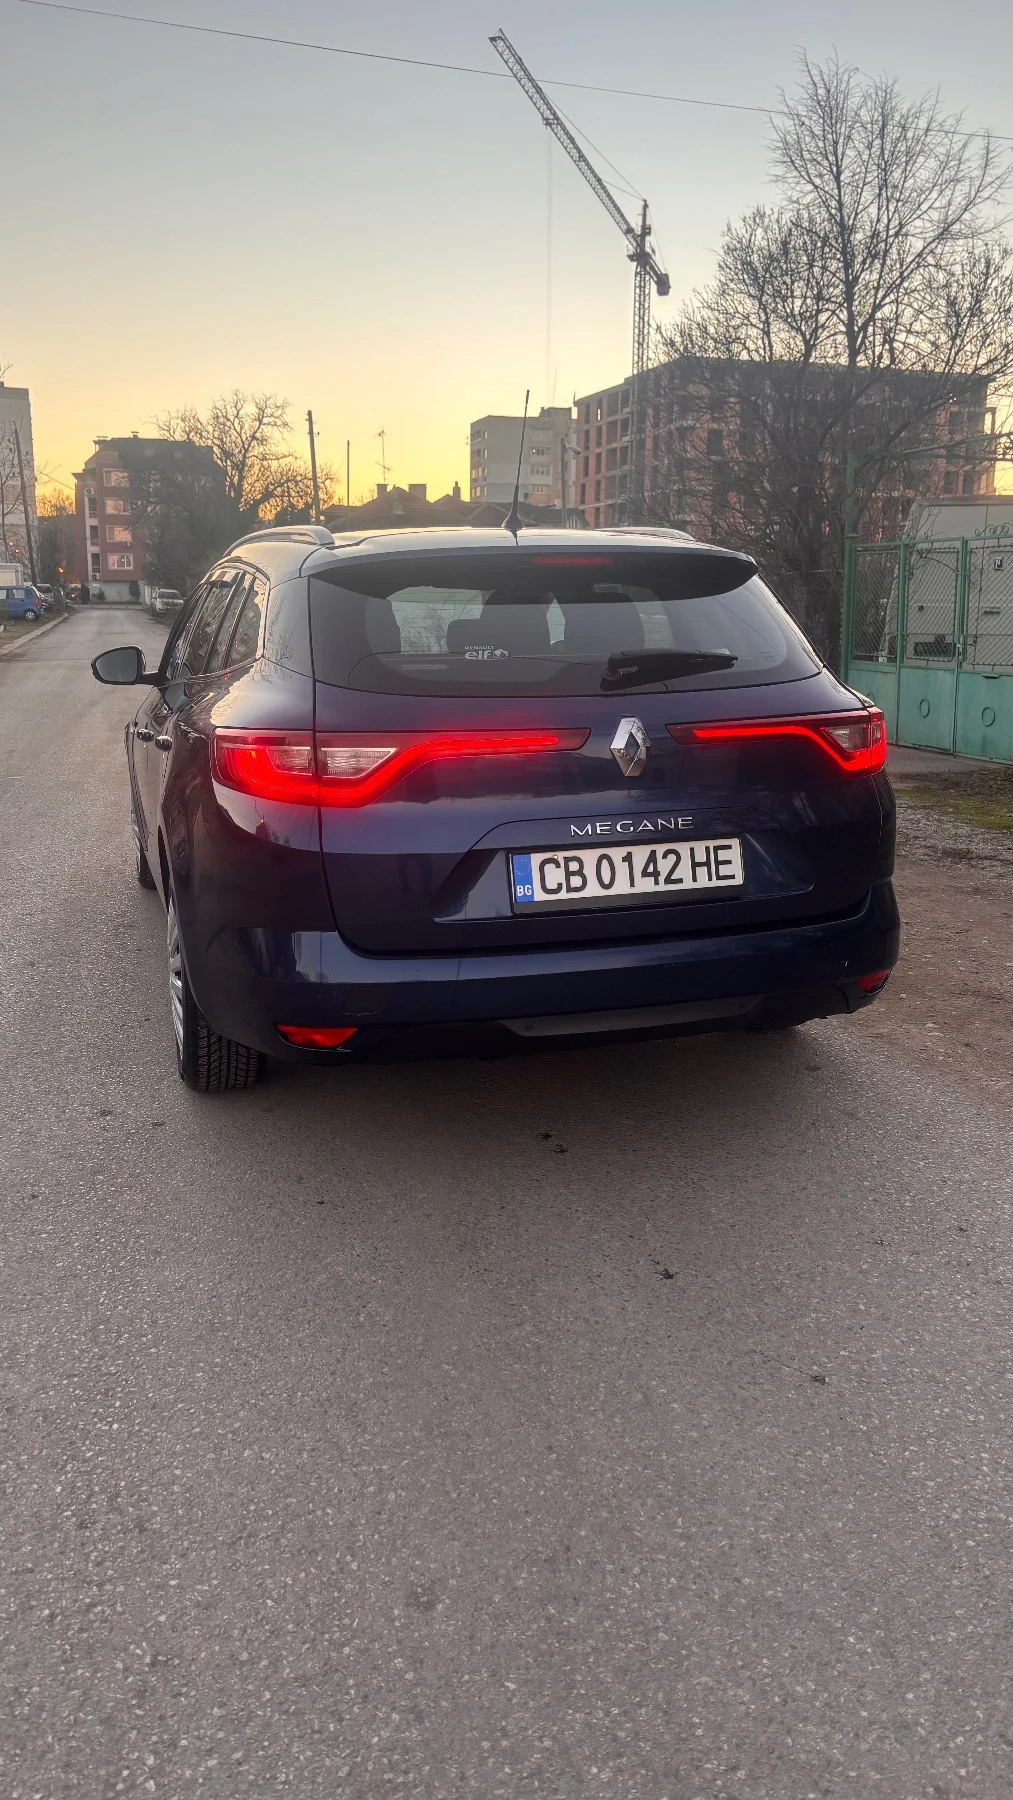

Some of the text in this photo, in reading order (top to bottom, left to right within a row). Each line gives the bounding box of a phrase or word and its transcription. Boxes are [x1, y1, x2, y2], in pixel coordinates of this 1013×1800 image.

[464, 649, 492, 660] elf
[570, 816, 695, 838] MEGANE
[516, 885, 533, 897] BG
